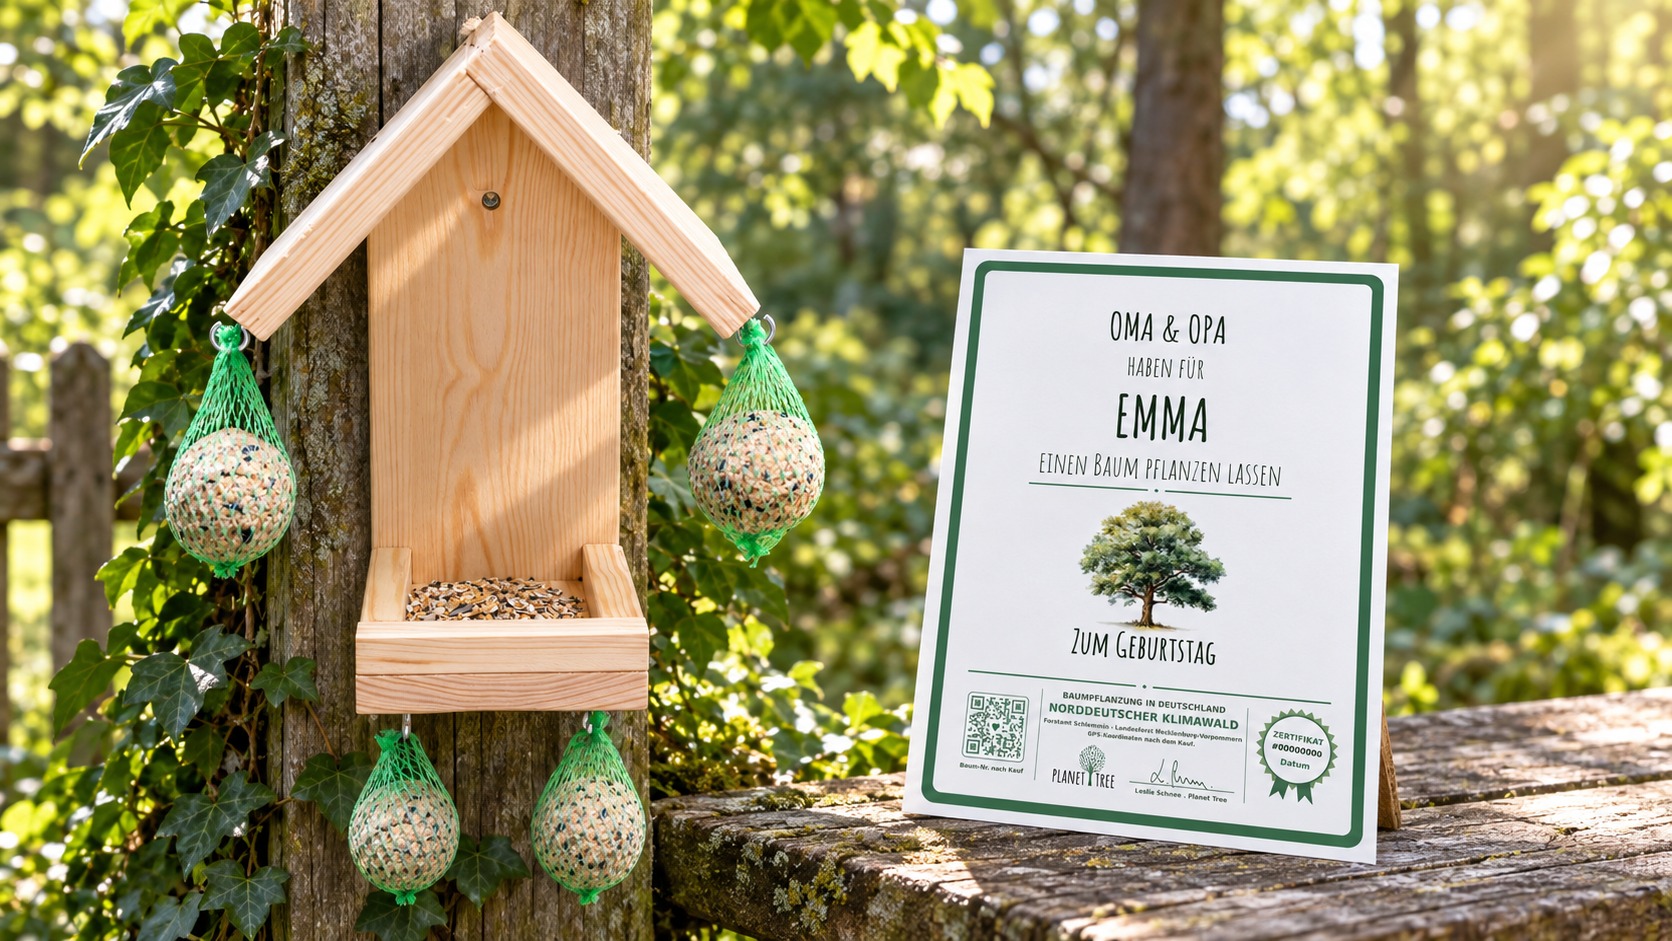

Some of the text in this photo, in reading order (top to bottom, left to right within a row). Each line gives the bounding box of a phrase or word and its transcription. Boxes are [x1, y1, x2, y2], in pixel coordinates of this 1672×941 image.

[1110, 310, 1226, 345] OMA & OPA
[1127, 356, 1204, 380] HABEN FÜR
[1116, 392, 1207, 443] EMMA
[1039, 452, 1282, 487] EINEN BAUM PFLANZEN LASSEN
[1071, 627, 1216, 666] ZUM GEBURTSTAG
[1062, 691, 1226, 714] BAUMPFLANZUNG IN DEUTSCHLAND
[1043, 717, 1072, 726] Forstamt
[1115, 724, 1154, 734] Landesforst
[1049, 702, 1239, 730] NORDDEUTSCHER KLIMAWALD
[1273, 730, 1324, 746] ZERTIFIKAT
[1271, 742, 1323, 758] #00000000
[1280, 758, 1310, 770] Datum
[1051, 768, 1115, 789] PLANET TREE
[1134, 787, 1155, 796] Leslie
[1156, 789, 1182, 798] Schnee
[1188, 793, 1211, 802] Planet
[1212, 795, 1228, 803] Tree
